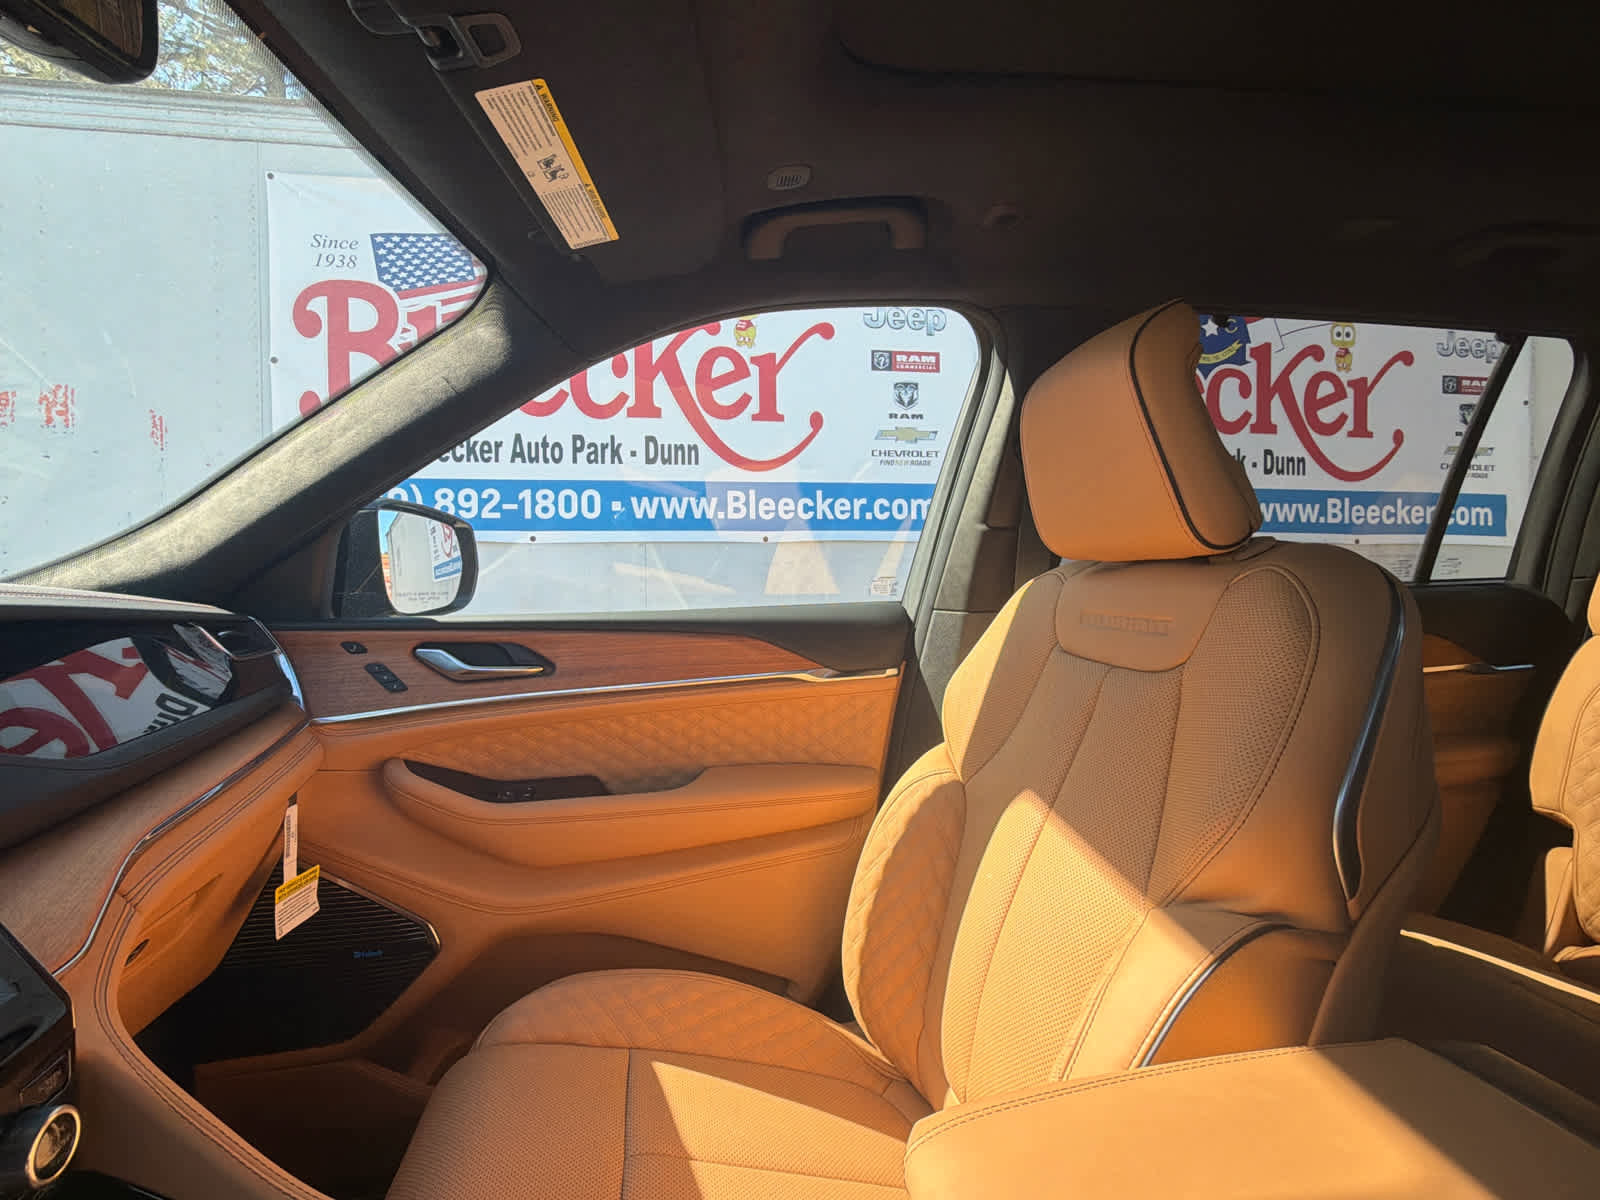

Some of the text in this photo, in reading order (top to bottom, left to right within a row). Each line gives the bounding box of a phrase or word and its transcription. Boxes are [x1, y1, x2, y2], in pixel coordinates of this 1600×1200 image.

[310, 233, 359, 250] Since
[315, 253, 358, 269] 1938
[863, 307, 947, 336] Jeep
[895, 354, 937, 363] RAM
[1436, 331, 1500, 364] Jeep
[1195, 342, 1414, 482] cker
[438, 432, 699, 466] cker Auto Park Dunn
[871, 449, 939, 458] CHEVROLET
[1263, 448, 1306, 476] Dunn
[434, 488, 601, 519] 892-1800
[630, 488, 932, 520] www.Bleecker.com
